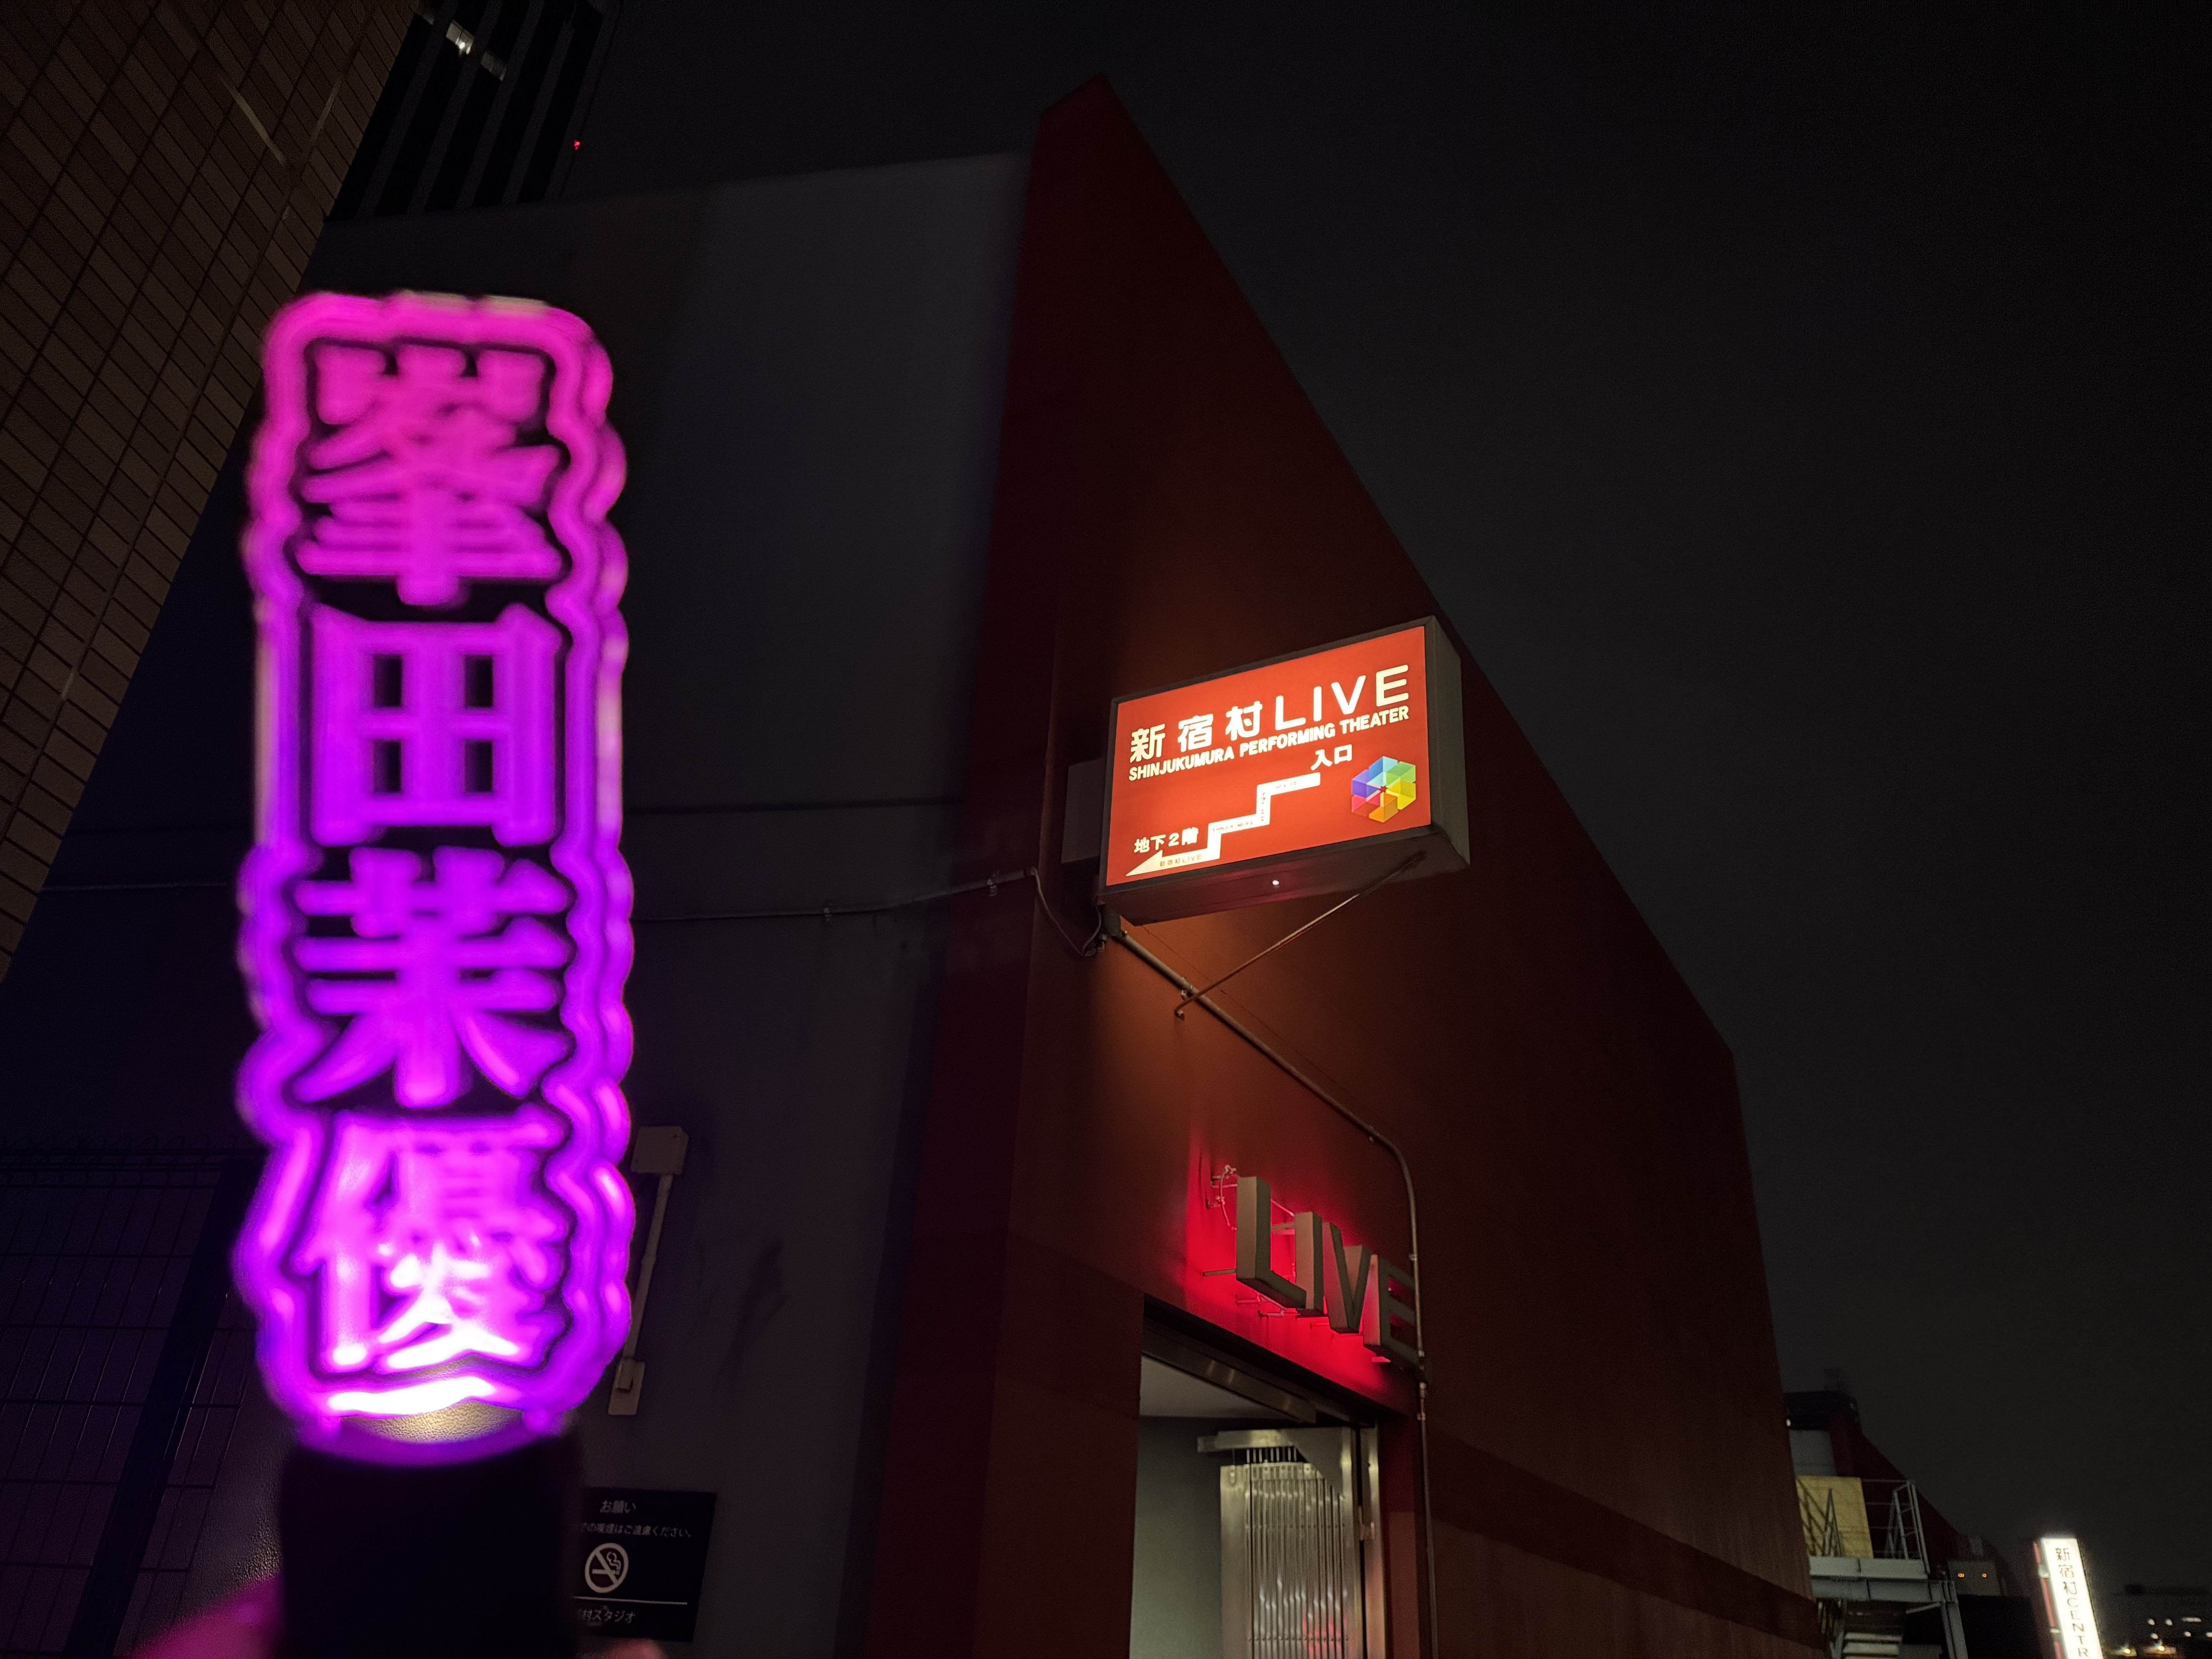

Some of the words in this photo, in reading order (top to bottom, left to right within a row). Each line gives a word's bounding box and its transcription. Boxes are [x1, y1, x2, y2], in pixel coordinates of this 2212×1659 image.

[1128, 746, 1235, 781] SHINJUKUMURA
[1239, 723, 1336, 759] PERFORMING
[1340, 706, 1410, 734] THEATER
[1129, 664, 1410, 763] 新宿村LIVE
[1310, 744, 1353, 771] 入口
[290, 342, 575, 1375] 峯田茉優
[1235, 1175, 1422, 1367] LIVE
